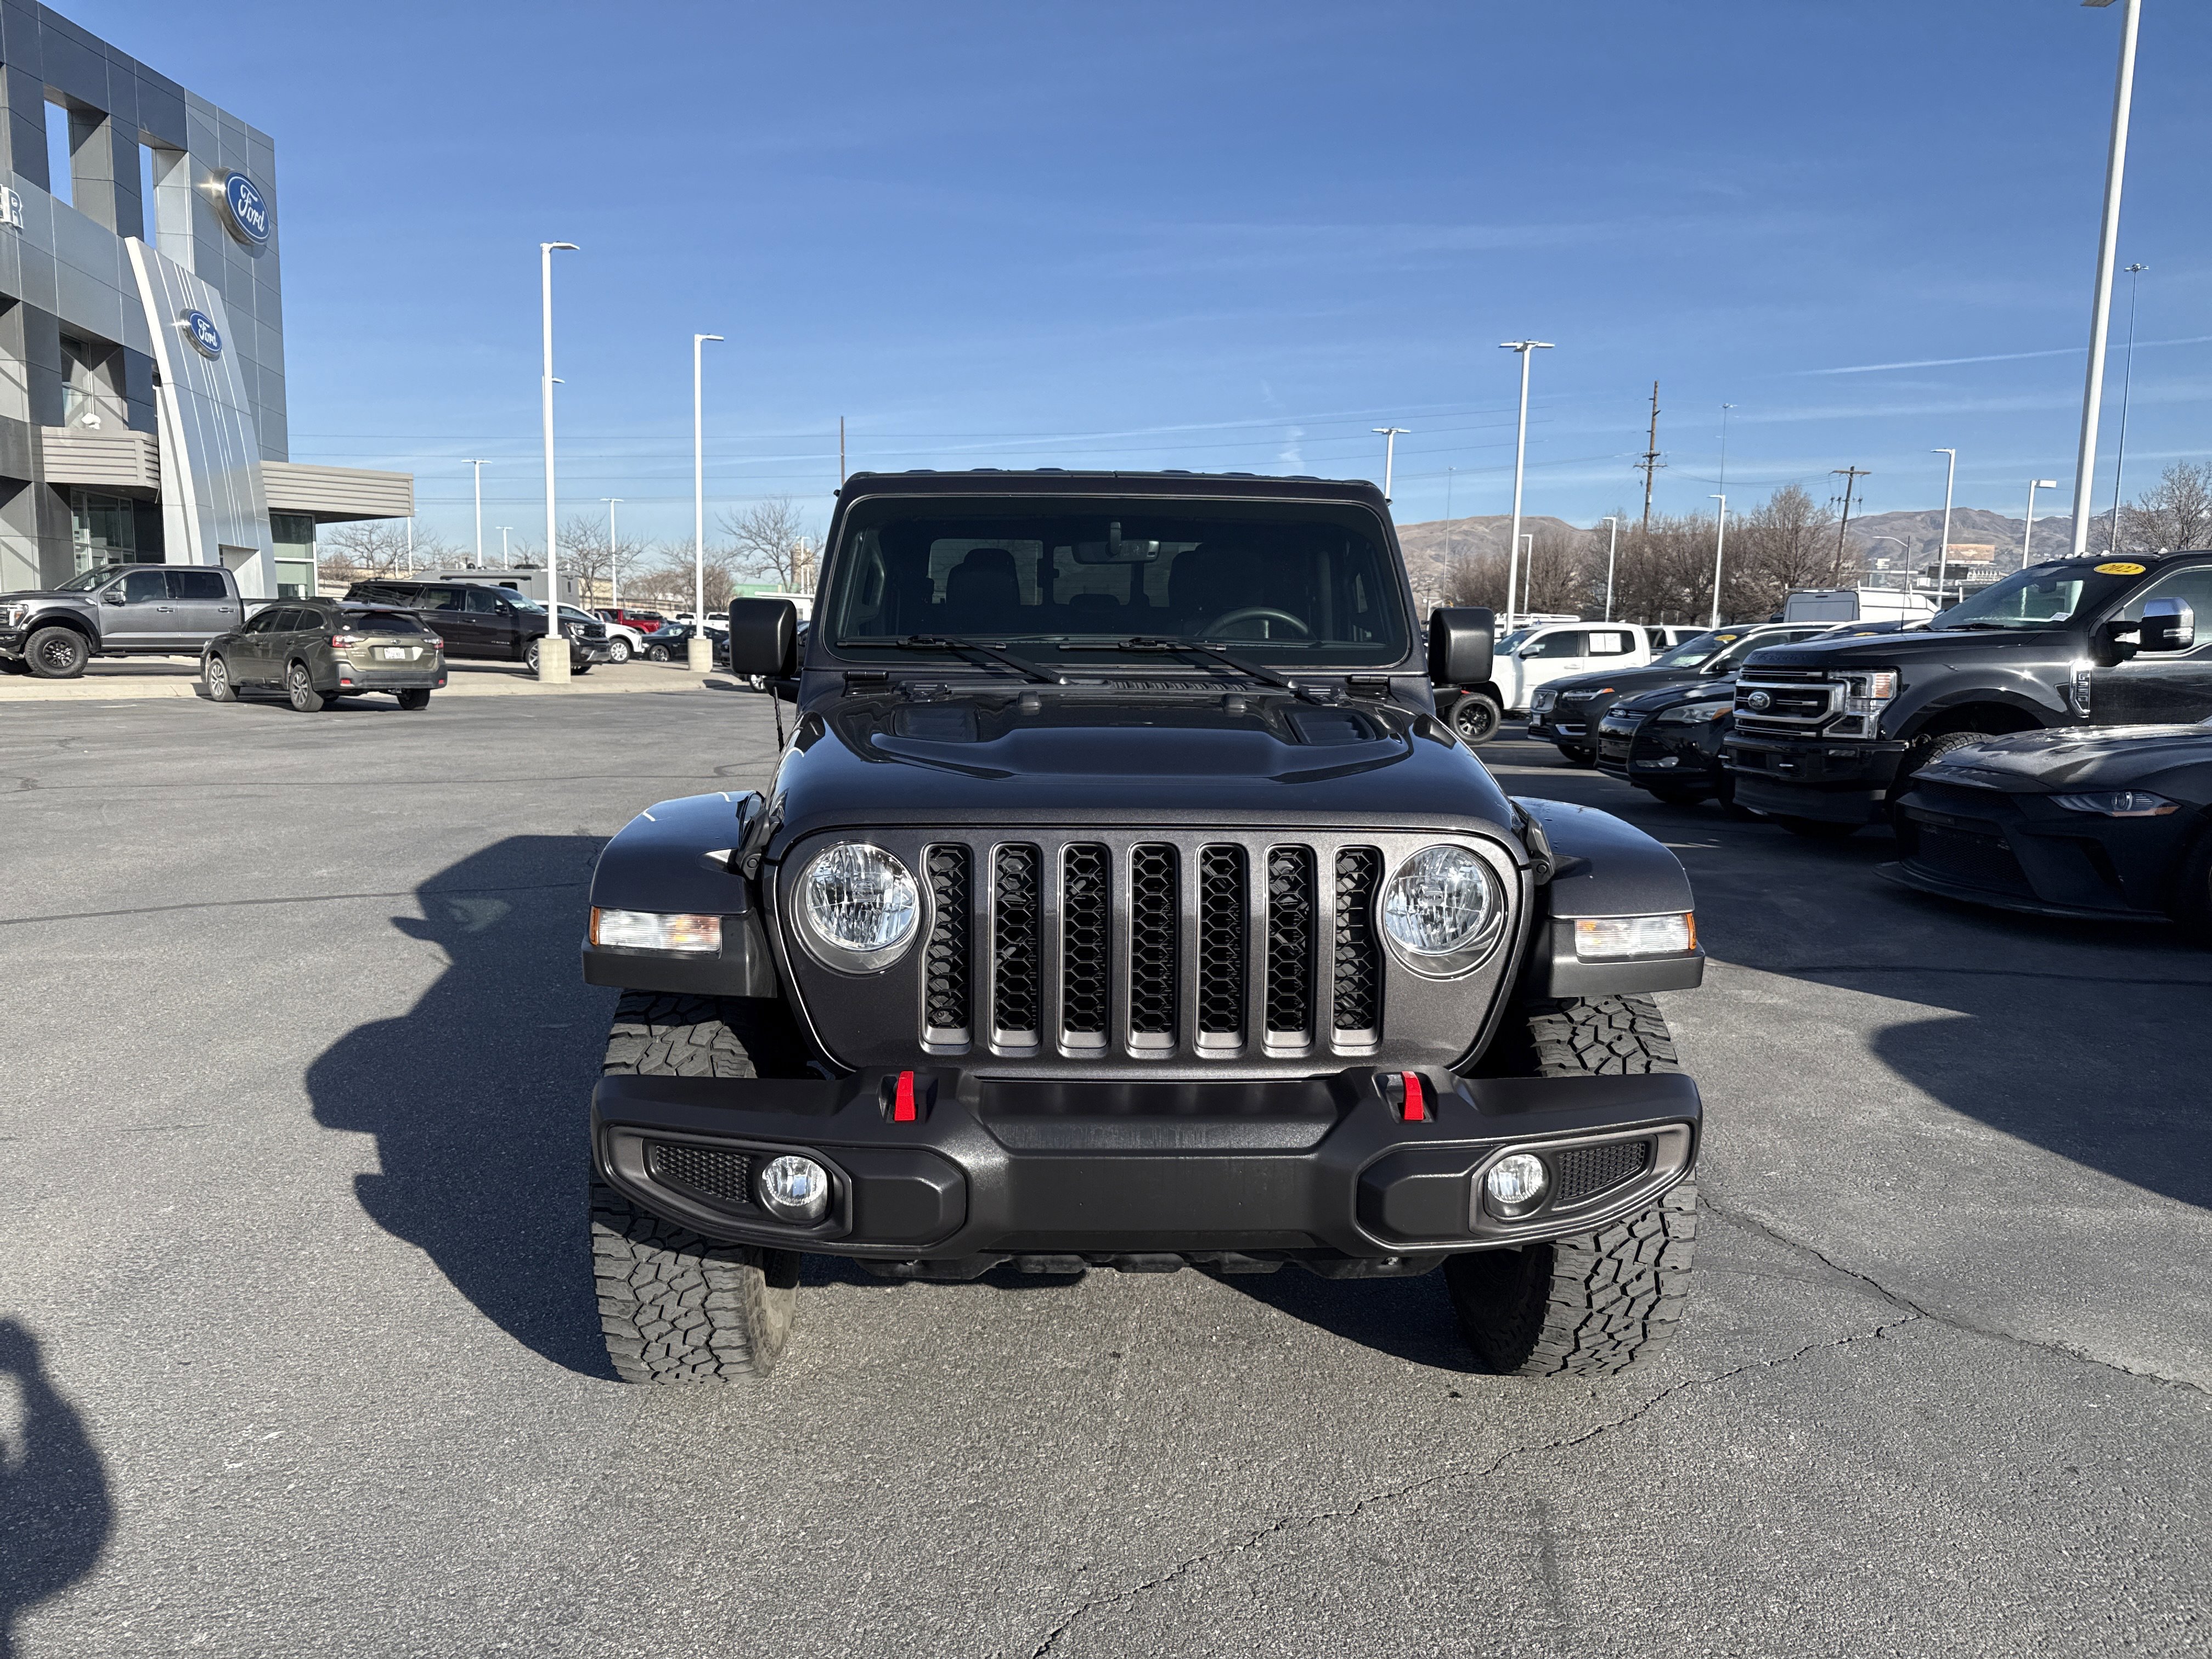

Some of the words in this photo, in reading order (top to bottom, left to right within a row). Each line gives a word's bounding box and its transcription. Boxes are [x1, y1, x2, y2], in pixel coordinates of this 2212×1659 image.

[0, 183, 24, 229] R
[238, 184, 264, 233] Ford
[198, 318, 218, 347] Ford
